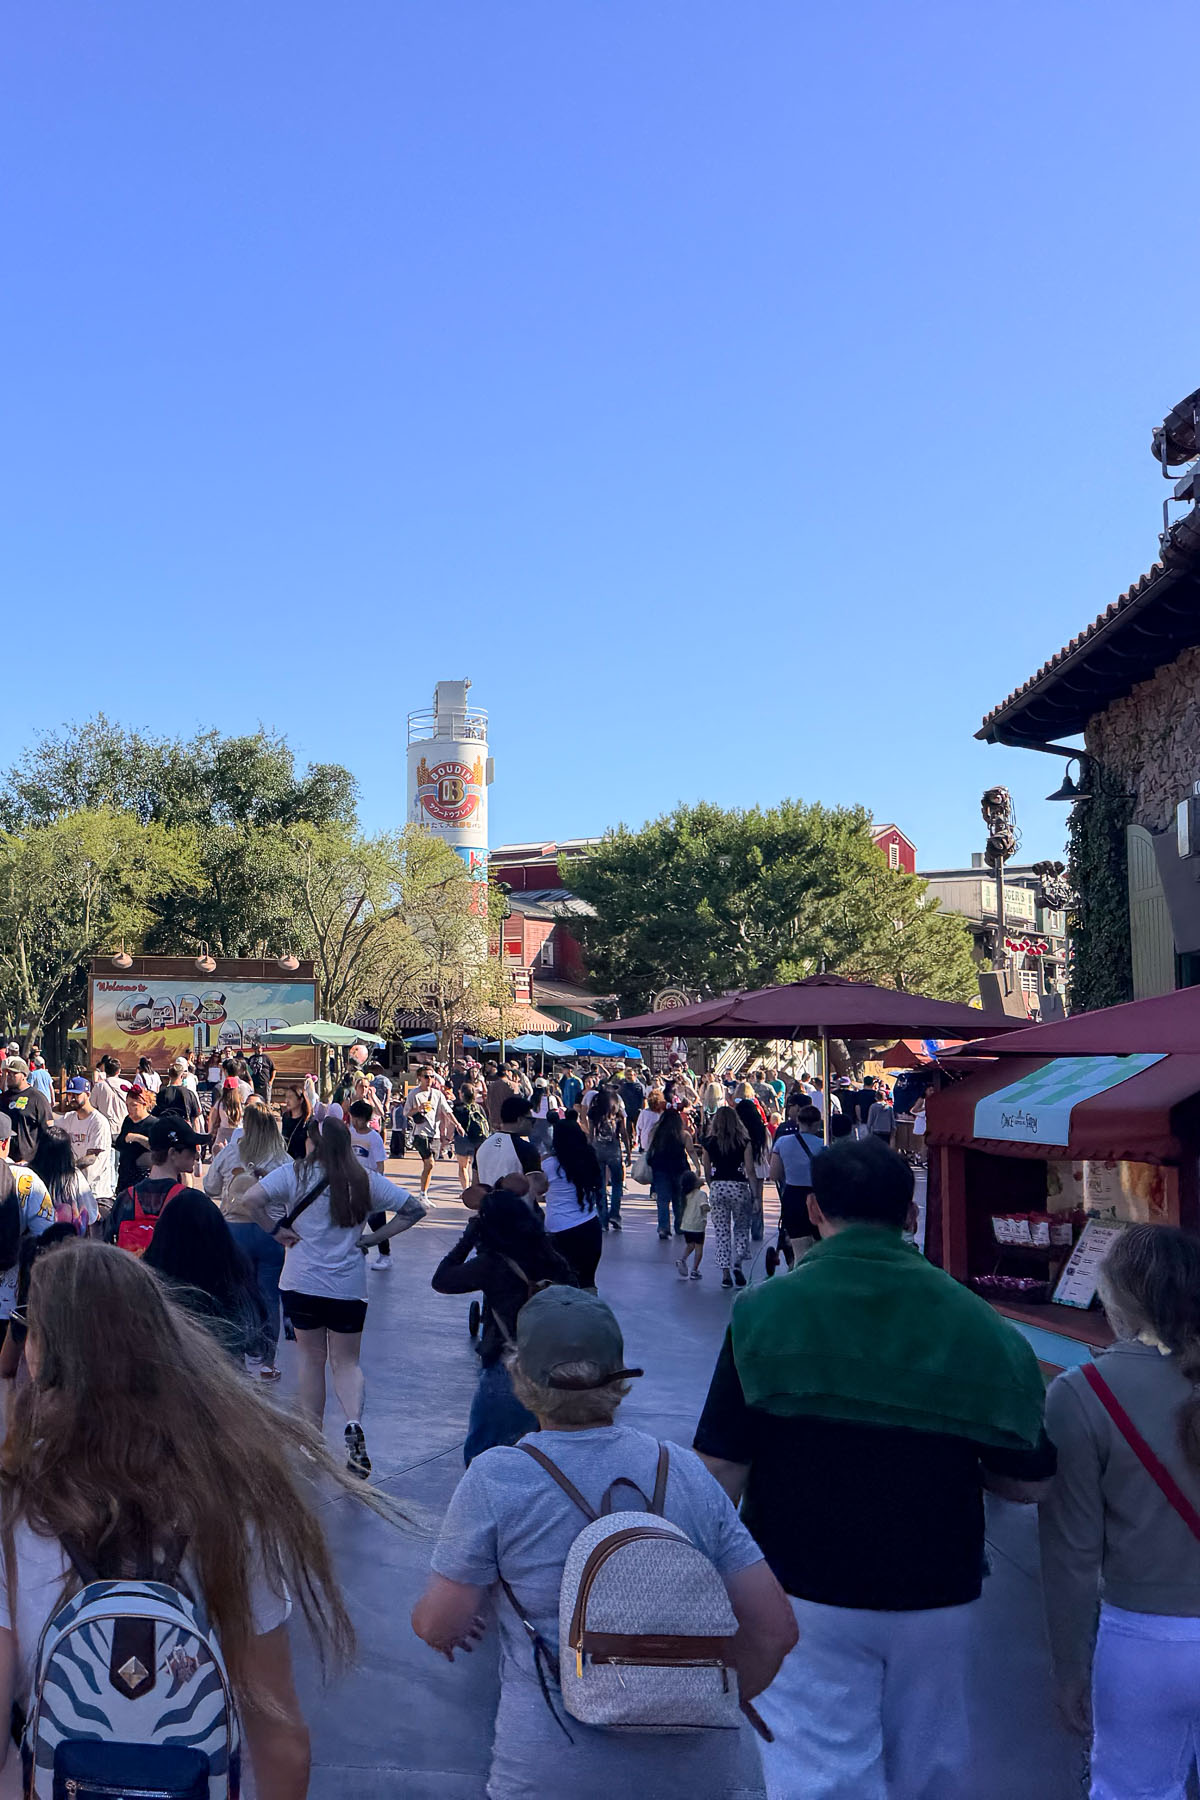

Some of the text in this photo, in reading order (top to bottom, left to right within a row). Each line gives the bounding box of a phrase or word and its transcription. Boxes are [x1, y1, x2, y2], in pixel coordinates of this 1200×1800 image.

[431, 765, 472, 781] BOUDIN
[96, 981, 148, 992] Welcome to
[115, 991, 228, 1035] CARS
[193, 1019, 292, 1056] LAND
